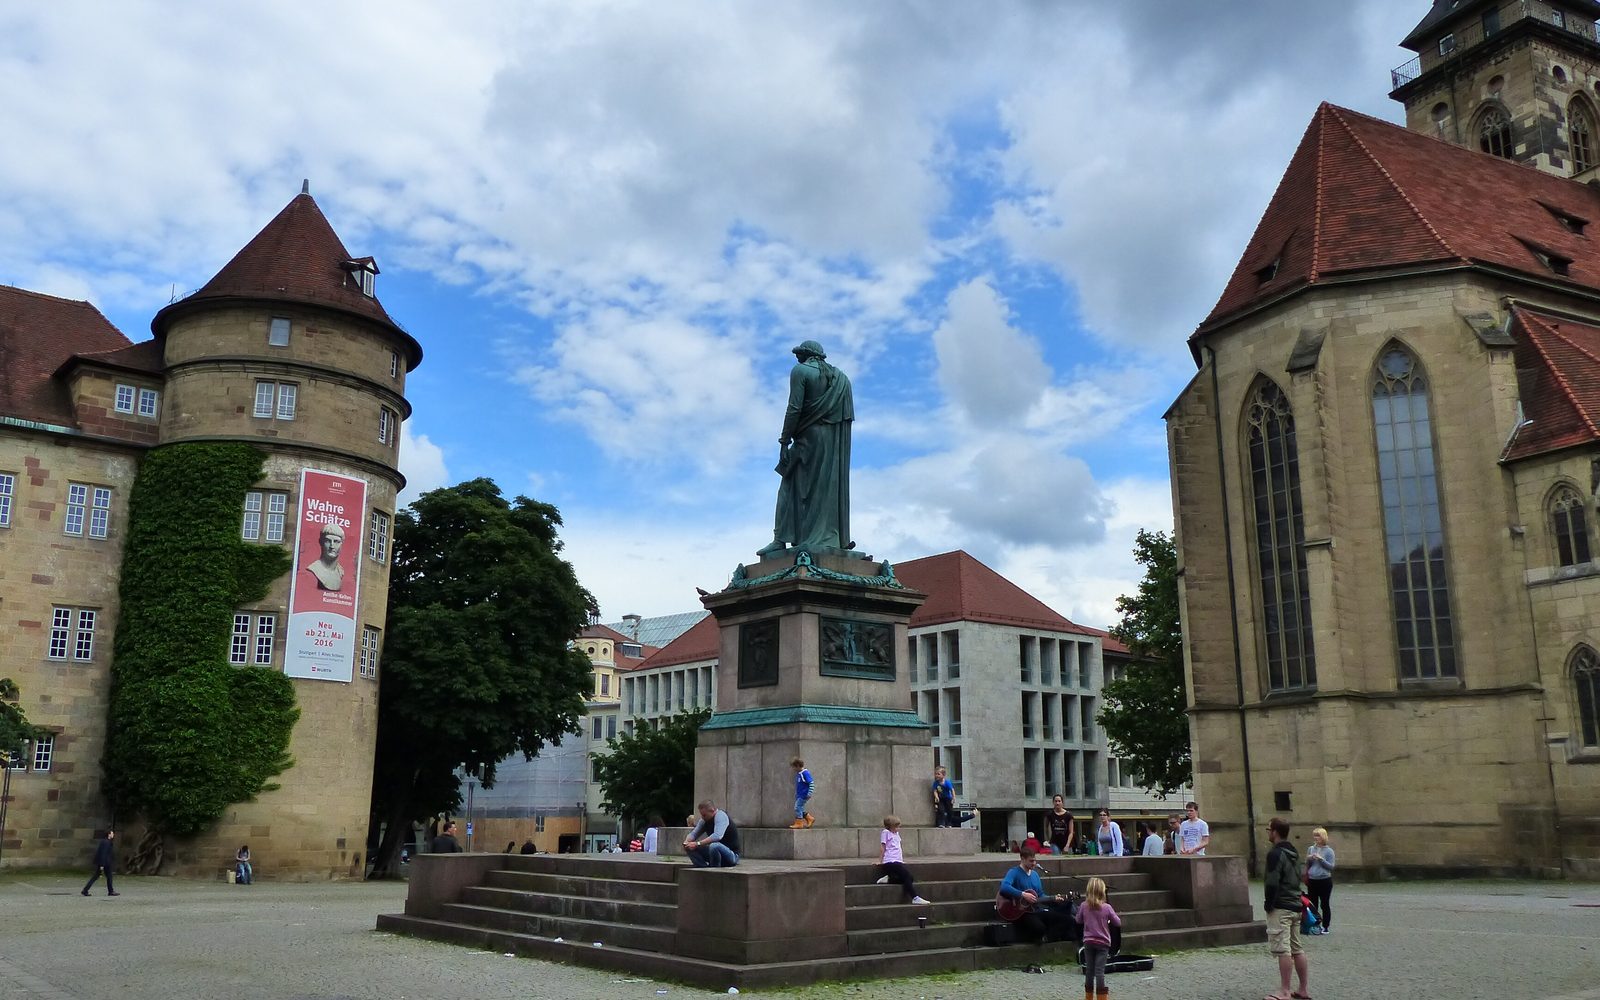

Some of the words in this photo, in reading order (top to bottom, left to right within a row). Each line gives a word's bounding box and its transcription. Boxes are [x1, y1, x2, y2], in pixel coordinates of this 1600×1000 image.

[307, 498, 344, 514] Wahre
[305, 510, 351, 528] Schätze
[318, 622, 332, 630] Neu
[317, 630, 329, 638] 21.
[330, 631, 344, 640] Mai
[314, 638, 334, 647] 2016
